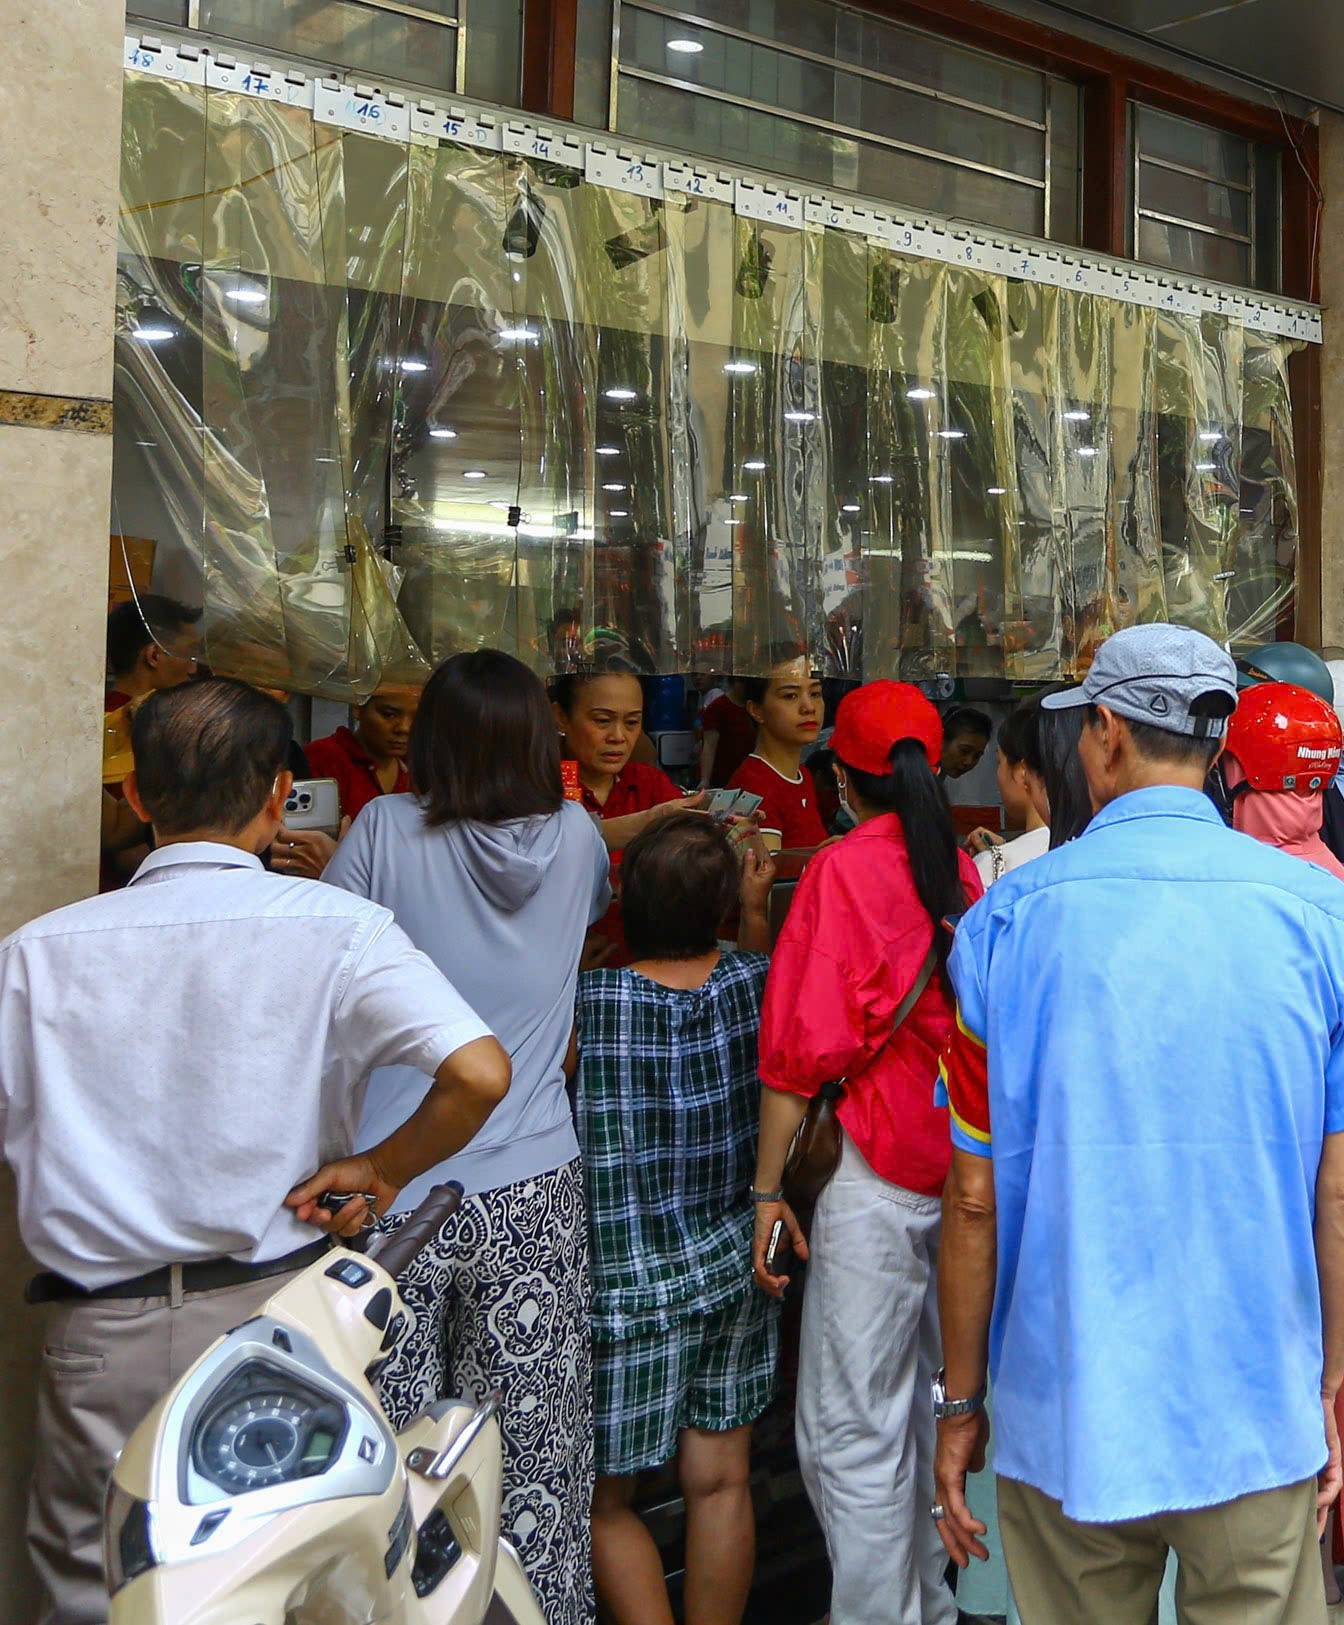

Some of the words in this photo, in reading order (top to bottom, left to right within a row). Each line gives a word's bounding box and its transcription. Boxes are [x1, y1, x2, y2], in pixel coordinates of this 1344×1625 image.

[128, 48, 154, 68] 18
[356, 101, 381, 119] 16
[443, 123, 459, 137] 15
[531, 143, 549, 158] 14
[626, 165, 644, 182] 13
[686, 178, 703, 194] 12
[775, 202, 788, 214] 11
[903, 231, 912, 247] 9
[965, 246, 973, 260] 8
[1020, 260, 1030, 273] 7
[1074, 270, 1082, 282] 6
[1123, 280, 1129, 292] 5
[1166, 294, 1174, 305] 4
[1217, 301, 1223, 312] 3
[1252, 310, 1261, 322] 2
[1297, 746, 1327, 760] Nhung
